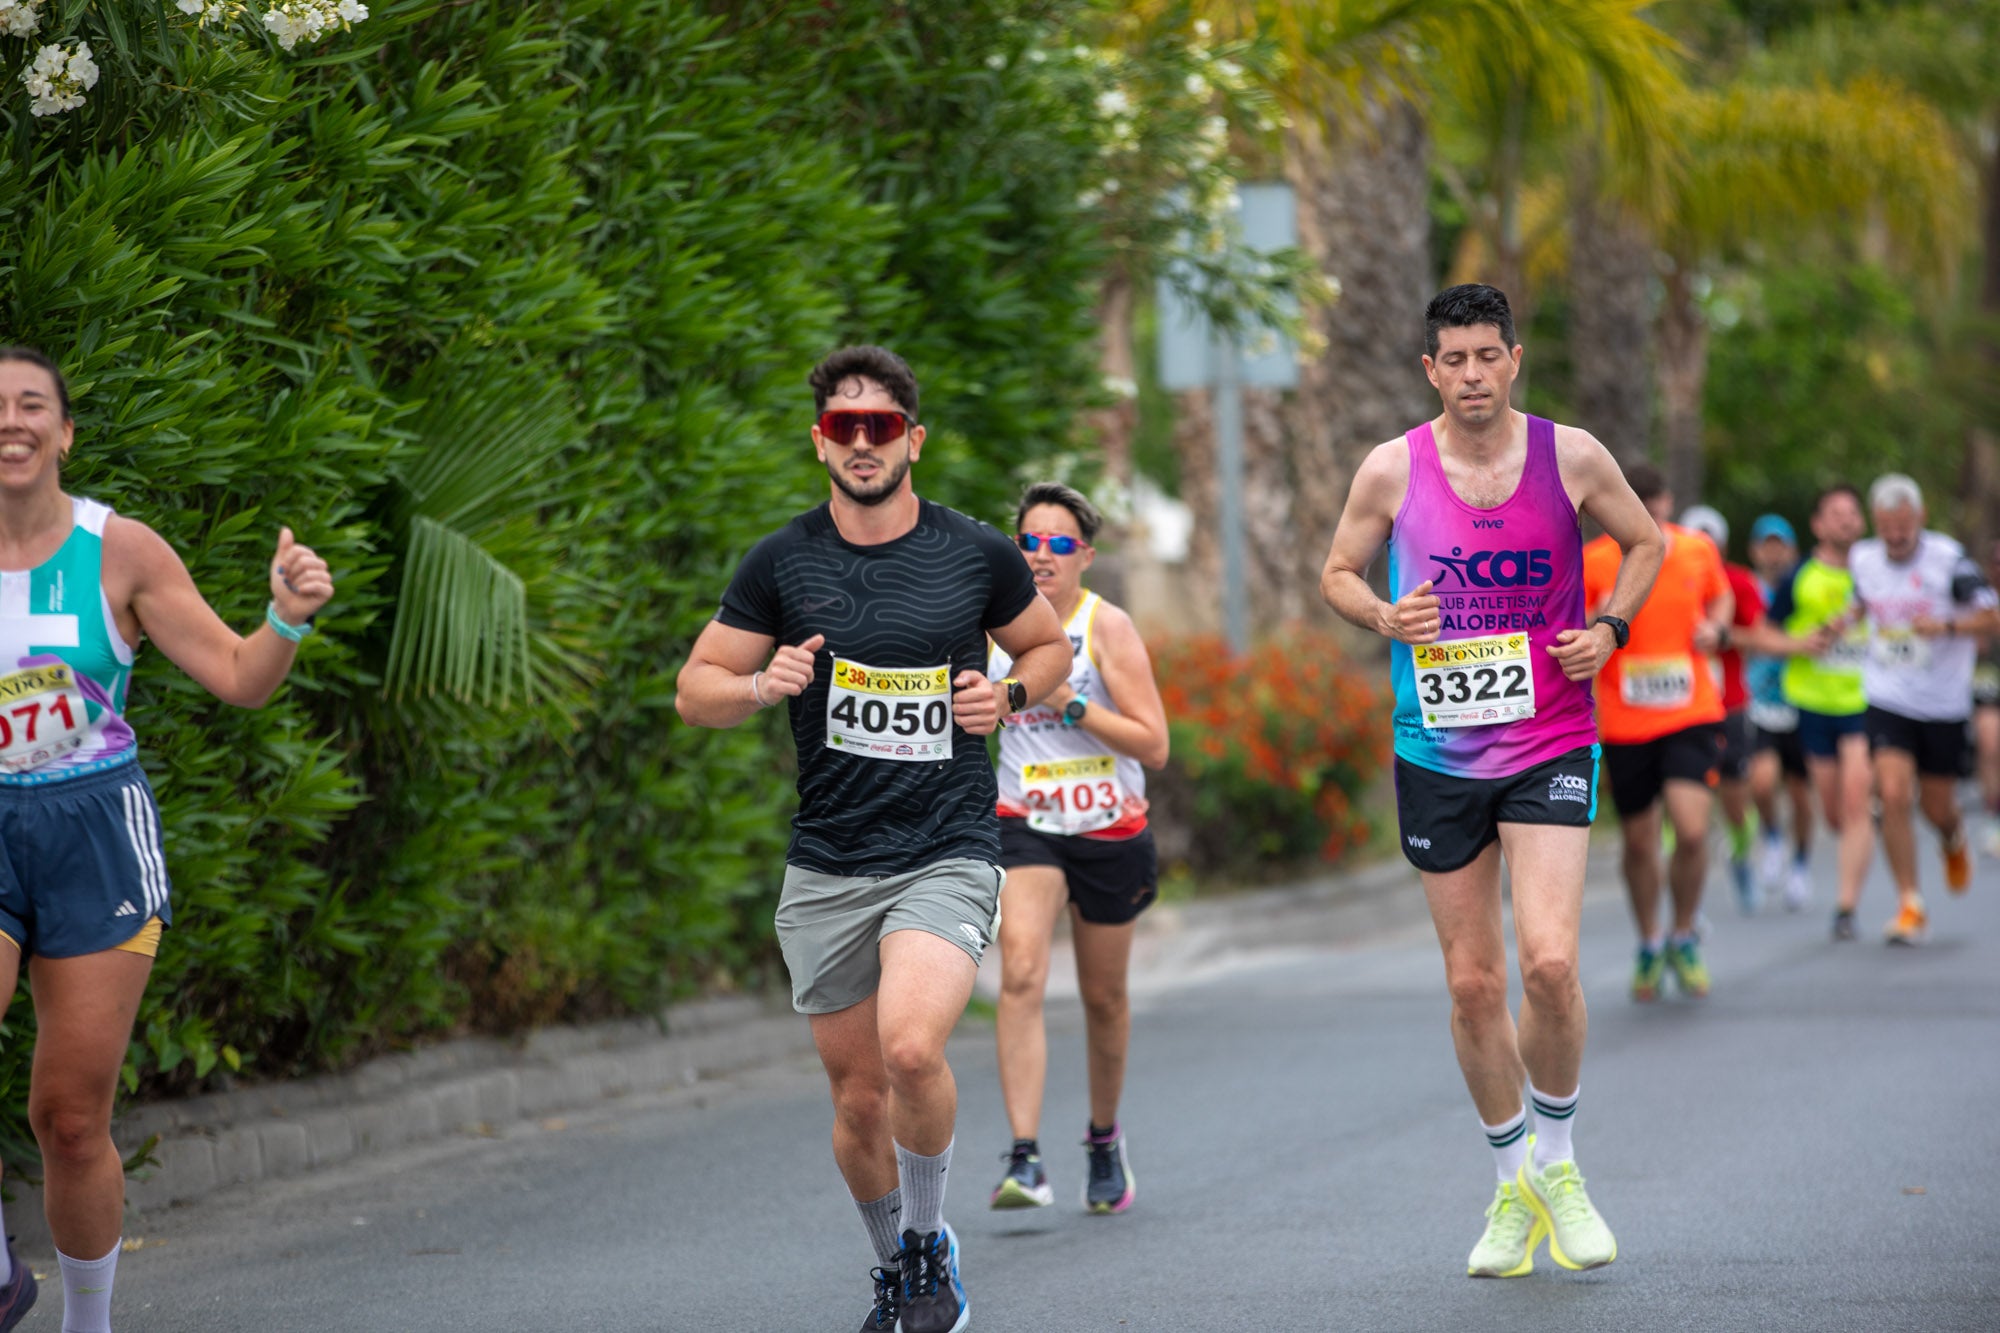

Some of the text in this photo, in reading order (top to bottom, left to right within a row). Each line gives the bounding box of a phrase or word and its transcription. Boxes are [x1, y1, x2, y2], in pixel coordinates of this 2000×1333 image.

[1472, 518, 1504, 529] vive
[1466, 549, 1553, 588] cas
[1438, 597, 1465, 610] LUB
[1438, 609, 1548, 631] ALOBREÑA
[1447, 640, 1497, 651] GRAN PREMIO
[1428, 647, 1445, 662] 38
[1445, 646, 1504, 662] FONDO
[848, 668, 866, 686] 38
[870, 672, 925, 680] GRAN PREMIO
[867, 677, 931, 691] FONDO
[1420, 665, 1530, 706] 3322
[831, 695, 948, 736] 4050
[1026, 781, 1119, 815] 2103
[1407, 835, 1431, 849] vive
